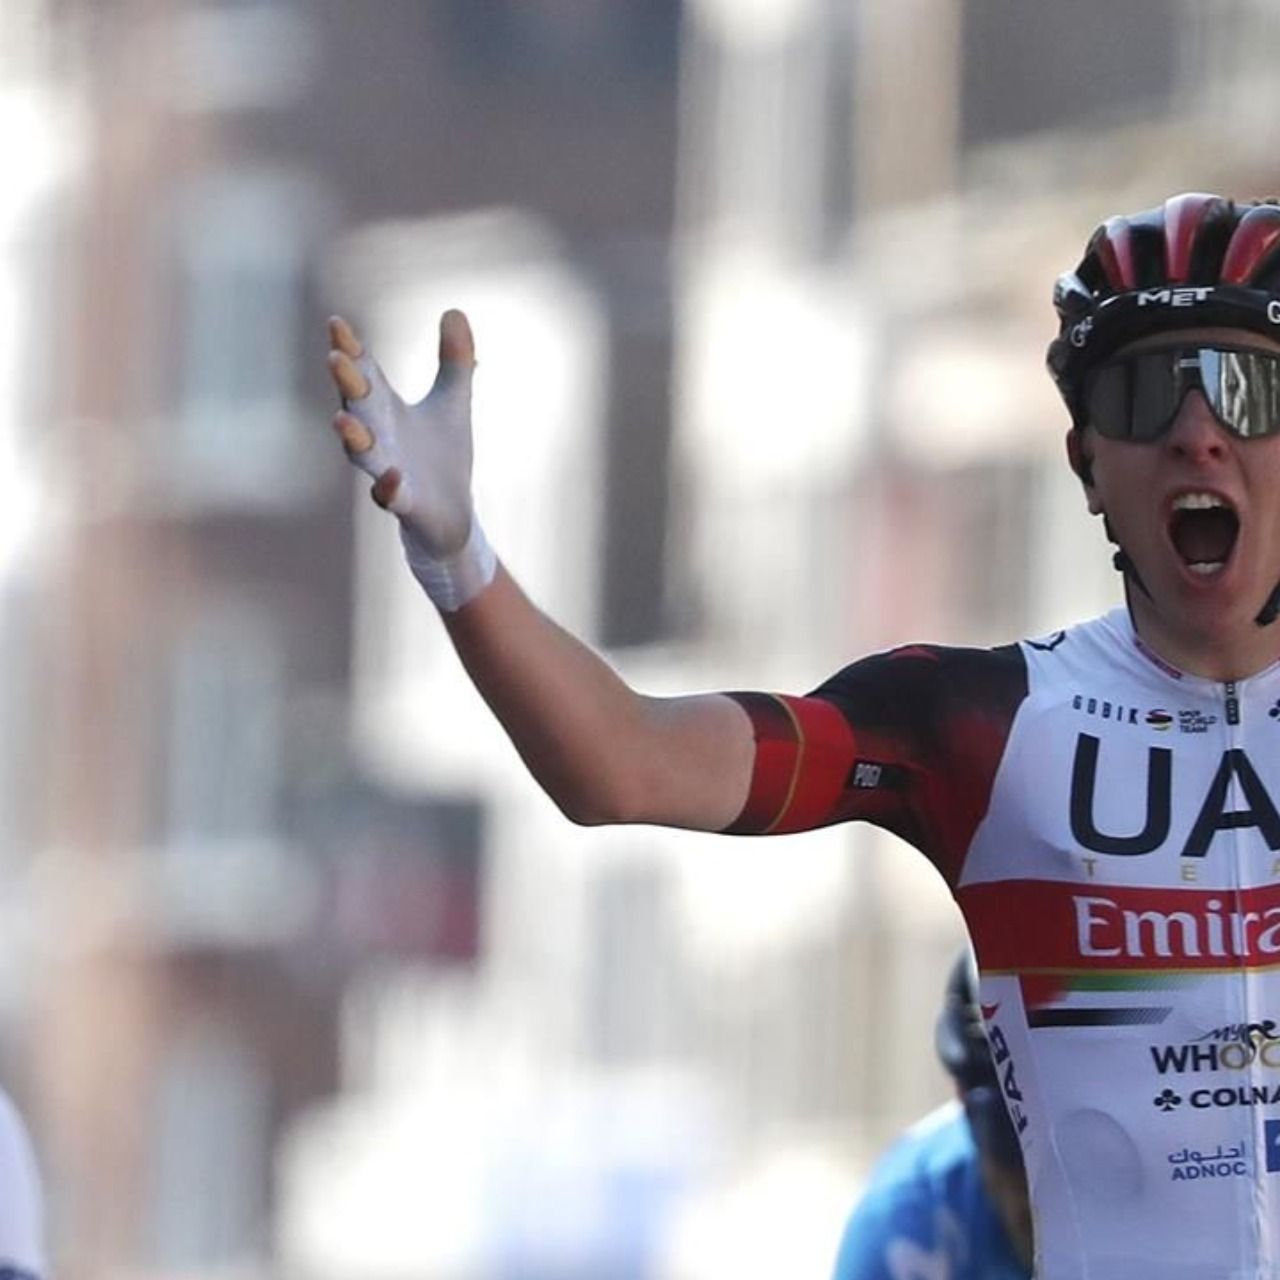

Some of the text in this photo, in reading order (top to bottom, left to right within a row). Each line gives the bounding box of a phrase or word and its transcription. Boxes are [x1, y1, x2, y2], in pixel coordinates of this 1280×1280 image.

[1137, 287, 1214, 306] MET
[1072, 694, 1139, 725] GOBIK
[1171, 1161, 1247, 1181] ADNOC
